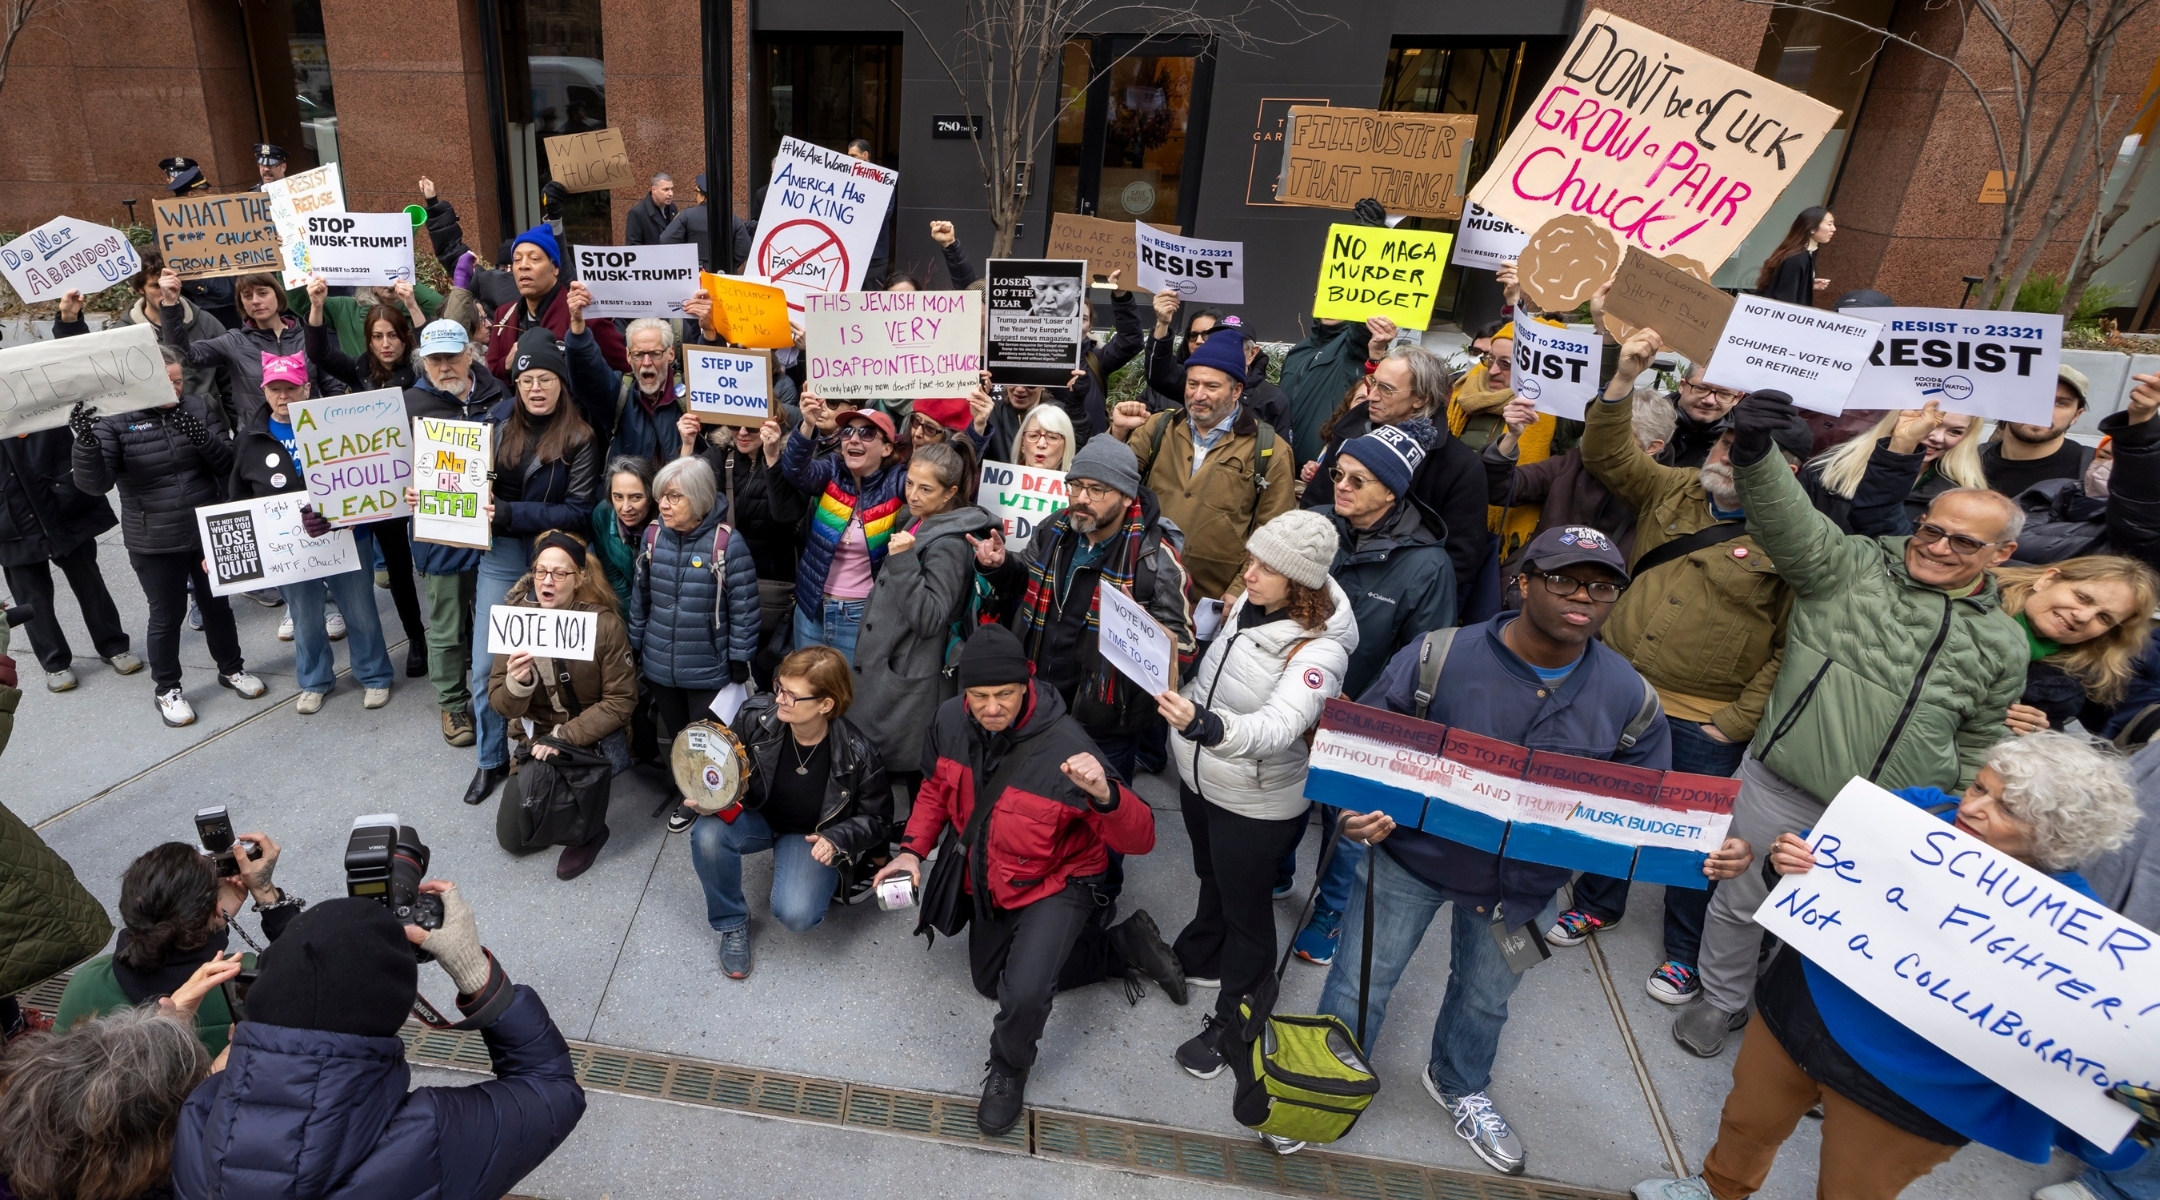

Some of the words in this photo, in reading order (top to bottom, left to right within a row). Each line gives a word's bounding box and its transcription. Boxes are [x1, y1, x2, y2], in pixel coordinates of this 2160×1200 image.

[1665, 85, 1691, 118] be
[938, 122, 960, 131] 780
[1535, 86, 1651, 162] GROW
[551, 131, 612, 157] WTF
[1292, 115, 1456, 159] FILIBUSTER
[1643, 142, 1660, 157] a
[285, 168, 329, 194] RESIST
[552, 153, 629, 189] CHUCK??
[774, 163, 834, 196] AMERICA
[1290, 157, 1361, 203] THAT
[1371, 166, 1453, 209] THANG!
[1645, 141, 1752, 227] PAIR
[158, 199, 232, 228] WHAT
[235, 197, 273, 223] THE
[292, 191, 336, 214] REFUSE
[781, 189, 805, 209] NO
[809, 195, 854, 224] KING
[308, 217, 355, 234] STOP
[1056, 224, 1082, 239] YOU
[1088, 232, 1114, 244] ARE
[310, 235, 408, 248] MUSK-TRUMP!
[1054, 241, 1104, 256] WRONG
[1141, 234, 1153, 244] TEXT
[1154, 238, 1186, 253] RESIST
[1200, 248, 1233, 257] 23321
[1332, 234, 1366, 260] NO
[1381, 240, 1436, 263] MAGA
[26, 236, 121, 295] ABANDON
[97, 240, 138, 281] US!
[168, 256, 214, 272] GROW
[219, 254, 230, 268] A
[234, 248, 276, 265] SPINE
[581, 252, 637, 268] STOP
[1142, 244, 1233, 278] RESIST
[1474, 250, 1498, 258] RESIST
[582, 268, 692, 282] MUSK-TRUMP!
[772, 256, 826, 280] FASCISM
[1330, 262, 1425, 286] MURDER
[720, 280, 774, 300] Schumer
[993, 278, 1030, 286] LOSER
[993, 289, 1008, 297] OF
[1010, 289, 1034, 297] THE
[1665, 270, 1710, 300] CLOTURE
[713, 296, 742, 314] Stand
[806, 294, 851, 312] THIS
[860, 292, 915, 312] JEWISH
[923, 294, 965, 313] MOM
[993, 300, 1021, 308] YEAR
[1328, 286, 1429, 308] BUDGET
[1617, 274, 1659, 300] SHUT
[1660, 294, 1674, 308] IT
[1678, 303, 1710, 329] DOWN
[840, 325, 863, 345] IS
[885, 317, 942, 343] VERY
[1745, 305, 1771, 316] NOT
[1771, 310, 1786, 320] IN
[1787, 314, 1814, 326] OUR
[1816, 320, 1866, 338] NAME!!!
[1892, 321, 1958, 333] RESIST
[1985, 325, 2042, 339] 23321
[1539, 338, 1548, 346] TO
[1550, 339, 1589, 354] 23321
[1728, 335, 1788, 356] SCHUMER
[1799, 352, 1830, 367] VOTE
[1832, 362, 1852, 372] NO
[1869, 338, 2042, 376] RESIST
[89, 346, 153, 389] NO
[701, 357, 732, 370] STEP
[736, 360, 754, 372] UP
[812, 354, 934, 379] DISAPPOINTED,
[938, 353, 980, 372] CHUCK
[1746, 356, 1762, 367] OR
[1765, 361, 1819, 380] RETIRE!!!
[718, 377, 738, 388] OR
[830, 384, 842, 395] only
[843, 382, 862, 394] happy
[864, 385, 873, 394] my
[920, 380, 934, 389] have
[935, 380, 944, 388] to
[691, 391, 720, 404] STEP
[724, 394, 768, 409] DOWN
[297, 409, 317, 432] A
[324, 397, 400, 424] (minority)
[304, 427, 406, 468] LEADER
[424, 421, 482, 452] VOTE
[310, 460, 412, 496] SHOULD
[438, 472, 462, 492] OR
[983, 466, 1013, 486] NO
[264, 502, 289, 520] Fight
[420, 490, 478, 518] GTFO
[1000, 492, 1067, 513] WITH
[211, 525, 234, 533] WHEN
[236, 522, 250, 530] YOU
[213, 529, 253, 548] LOSE
[1579, 532, 1597, 540] DAY
[215, 547, 231, 556] IT'S
[233, 544, 255, 552] OVER
[217, 554, 240, 562] WHEN
[242, 551, 256, 559] YOU
[269, 542, 294, 555] Step
[308, 549, 346, 567] Chuck!
[219, 558, 257, 579] QUIT
[1373, 593, 1396, 605] Columbia
[1113, 600, 1138, 627] VOTE
[1140, 621, 1154, 638] NO
[492, 613, 547, 647] VOTE
[556, 615, 586, 651] NO!
[1126, 628, 1139, 646] OR
[1108, 628, 1127, 653] TIME
[1130, 646, 1141, 663] TO
[1144, 659, 1159, 676] GO
[1323, 706, 1403, 737] SCHUMER
[1473, 746, 1496, 763] TO
[1603, 776, 1629, 792] OR
[1634, 782, 1682, 798] STEP
[1682, 789, 1735, 807] DOWN
[1396, 749, 1475, 781] CLOTURE
[1316, 741, 1389, 768] WITHOUT
[1473, 782, 1510, 802] AND
[1628, 816, 1703, 840] BUDGET!
[1810, 834, 1862, 884] Be
[1885, 886, 1908, 912] a
[1910, 830, 2151, 970] SCHUMER
[1775, 888, 1842, 931] Not
[1848, 934, 1873, 960] a
[1894, 952, 2150, 1092] COLLABORATO
